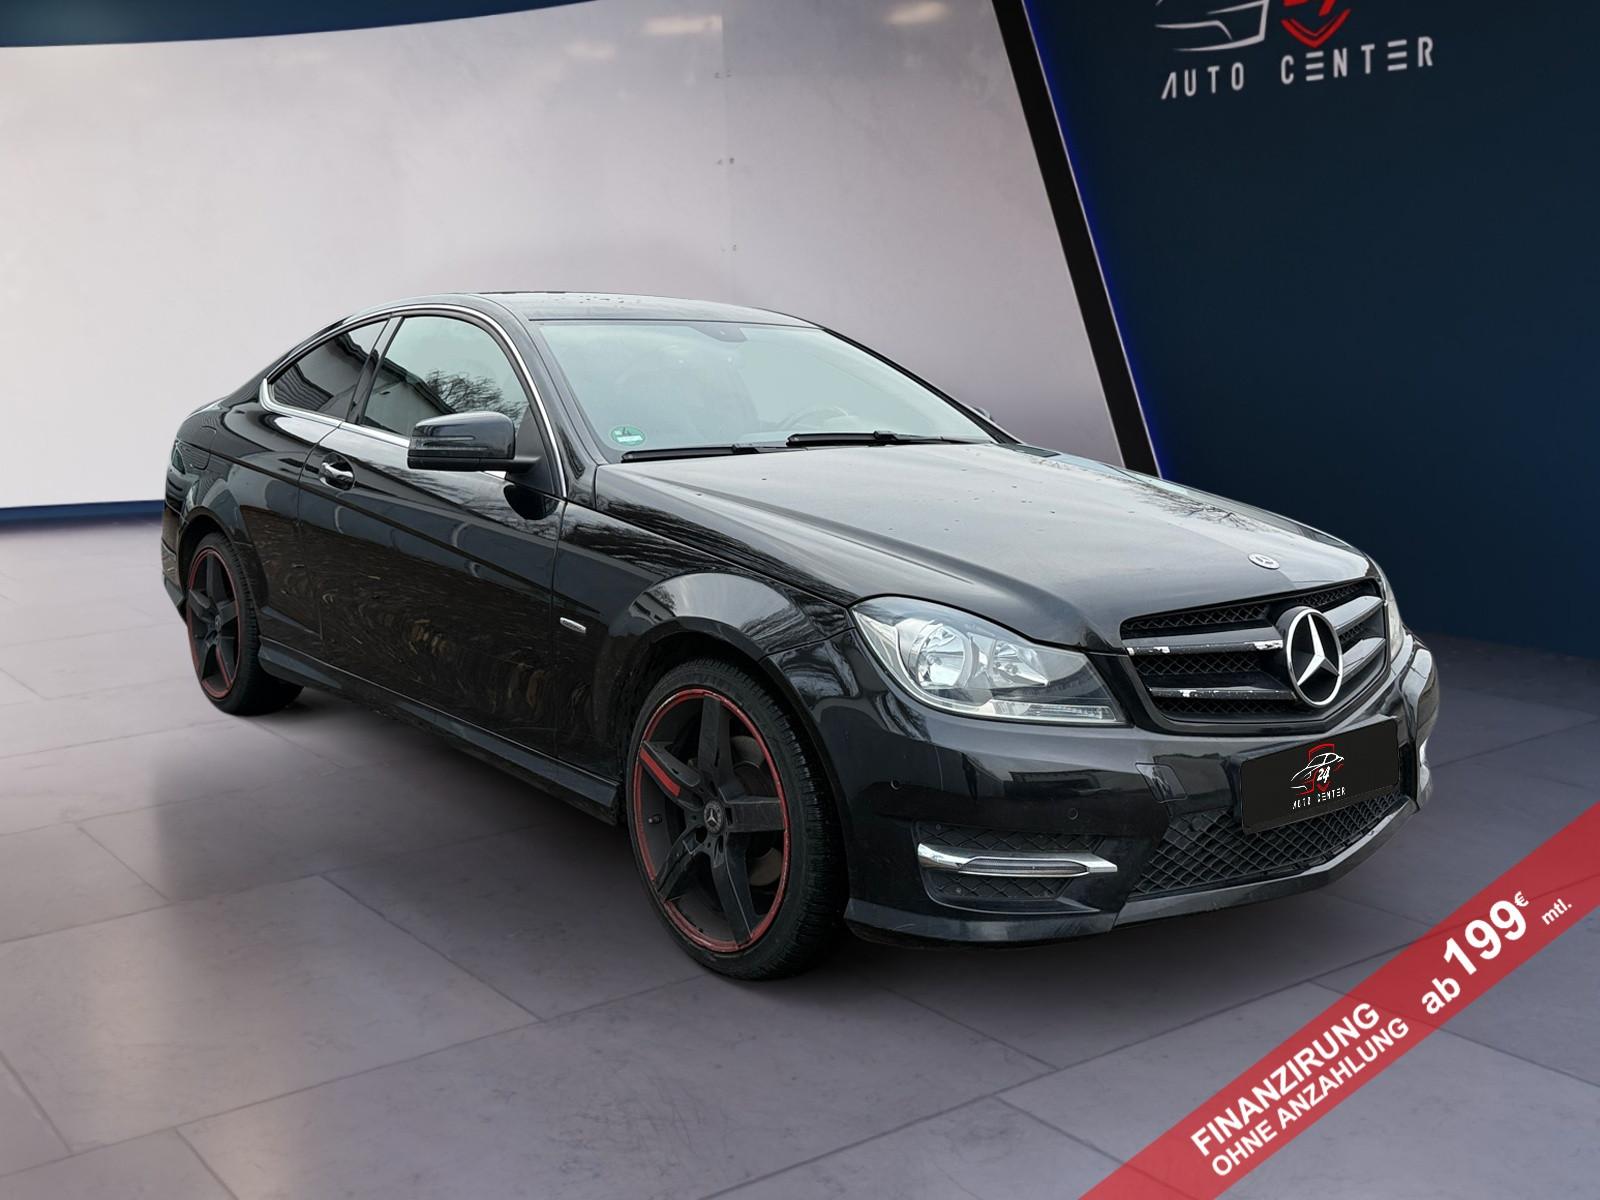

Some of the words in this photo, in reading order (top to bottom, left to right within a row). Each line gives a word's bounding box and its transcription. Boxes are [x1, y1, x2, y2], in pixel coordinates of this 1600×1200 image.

[1161, 62, 1245, 100] AUTO
[1281, 36, 1434, 85] CENTER
[1316, 766, 1330, 783] 24
